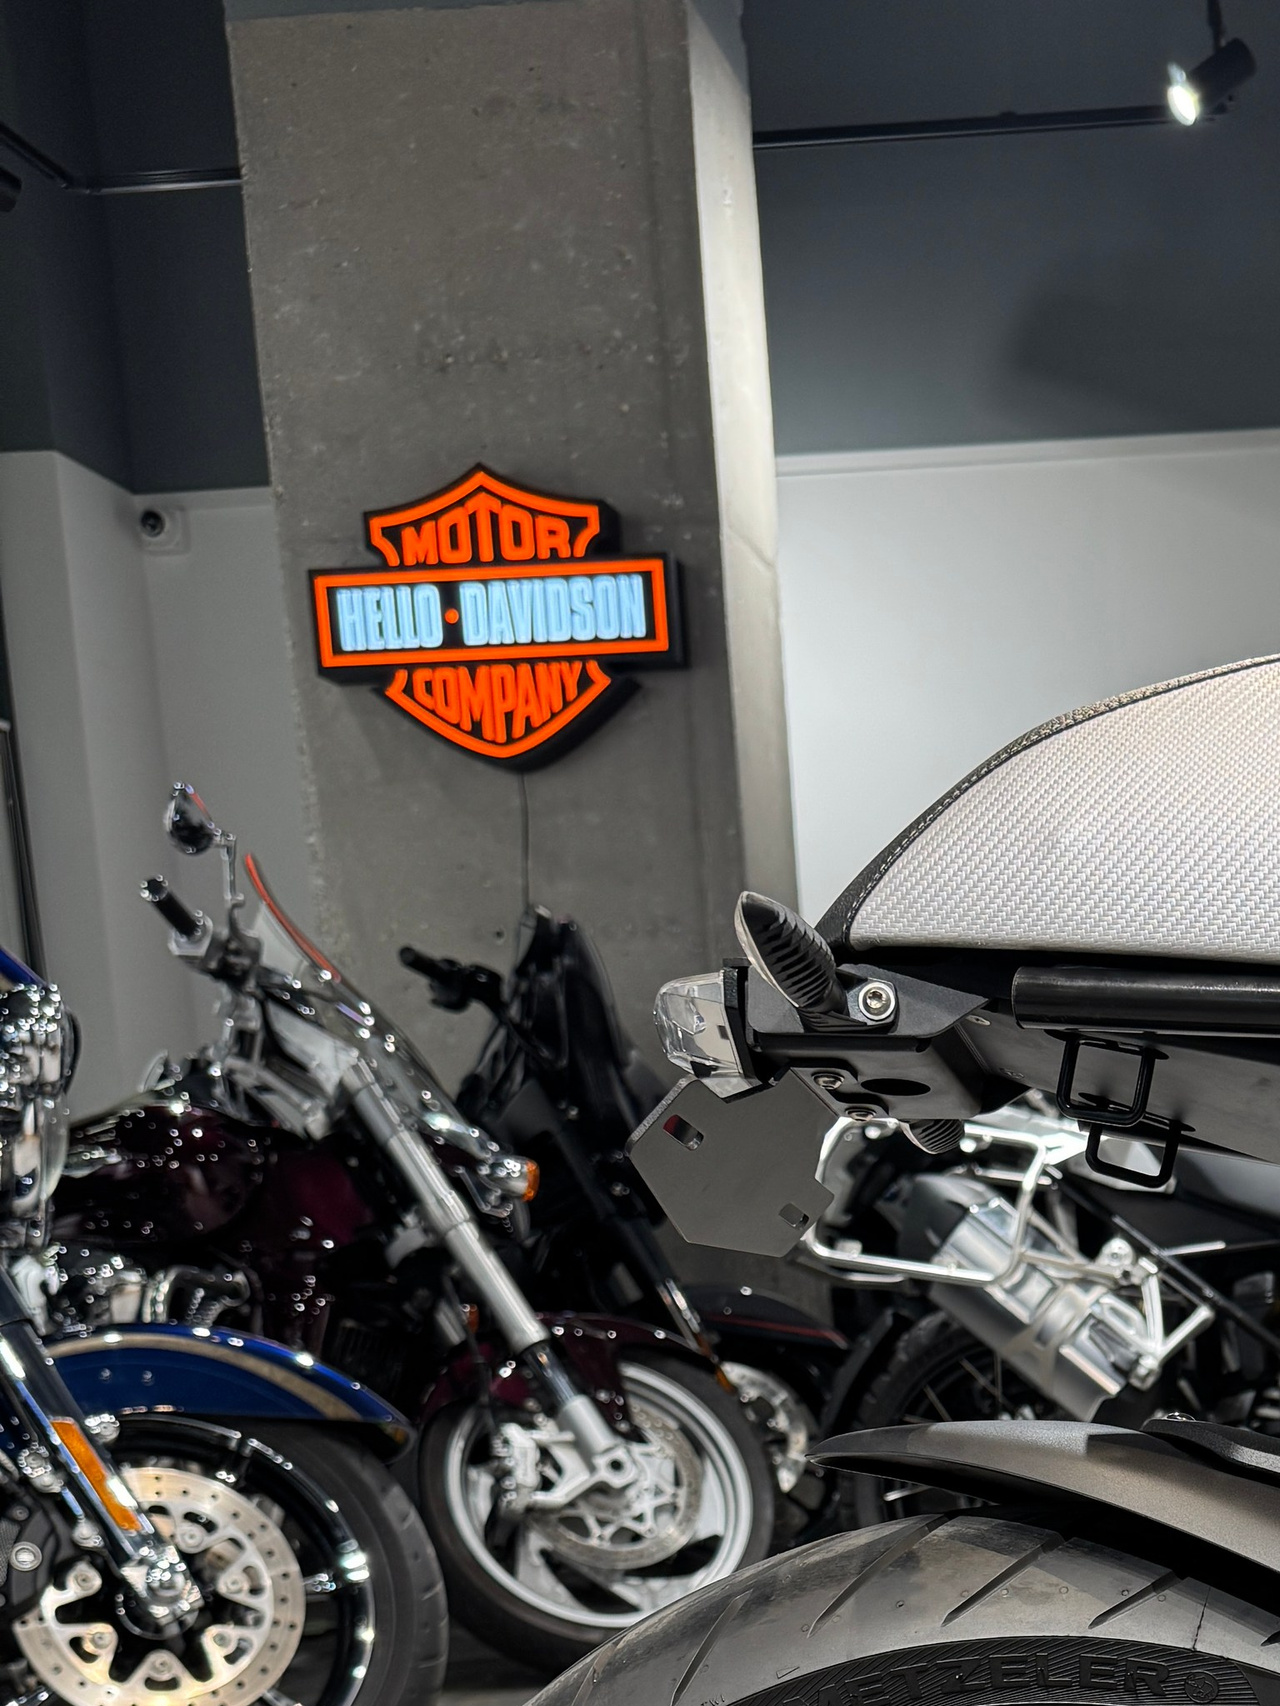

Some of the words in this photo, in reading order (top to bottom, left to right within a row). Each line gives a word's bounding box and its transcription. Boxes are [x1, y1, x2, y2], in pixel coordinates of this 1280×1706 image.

[401, 491, 571, 566] MOTOR
[336, 583, 443, 652] HELLO
[459, 573, 646, 646] DAVIDSON
[412, 661, 583, 744] COMPANY
